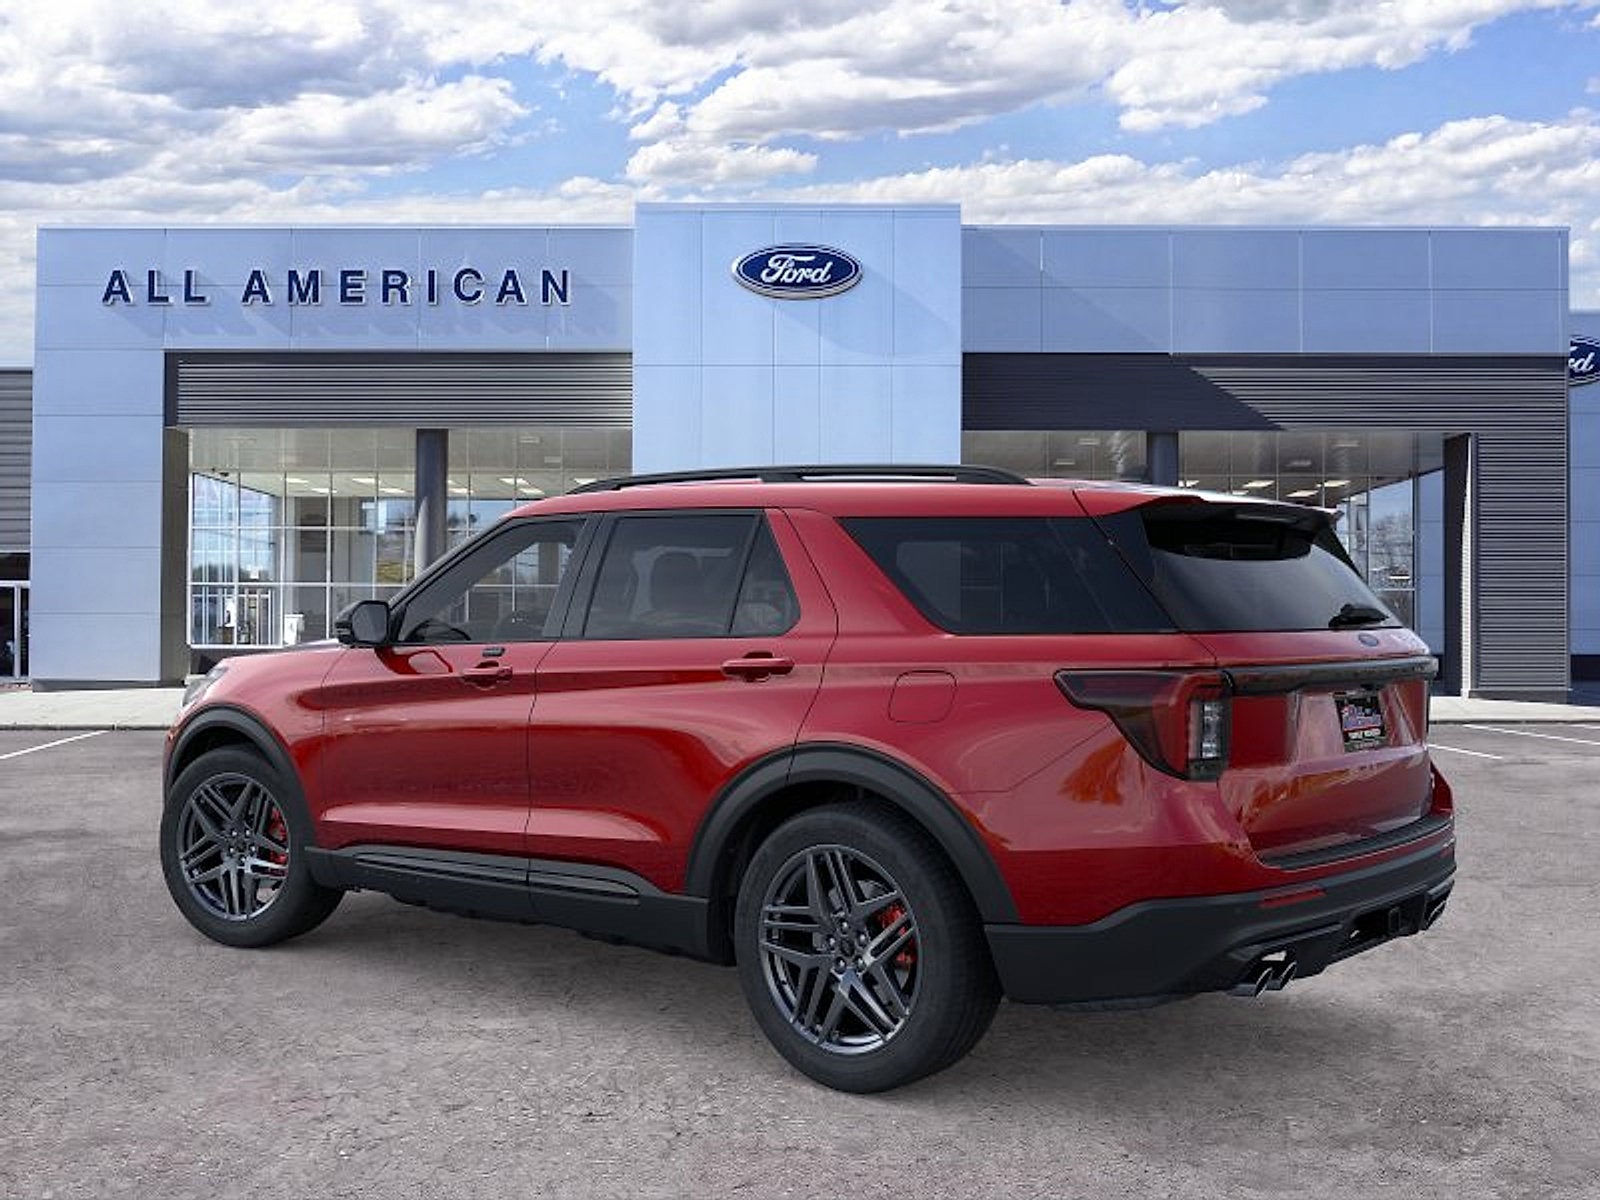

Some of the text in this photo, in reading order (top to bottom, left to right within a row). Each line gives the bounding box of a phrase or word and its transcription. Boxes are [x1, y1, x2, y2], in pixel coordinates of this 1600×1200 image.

[761, 254, 833, 283] Ford
[102, 269, 571, 304] ALL AMERICAN
